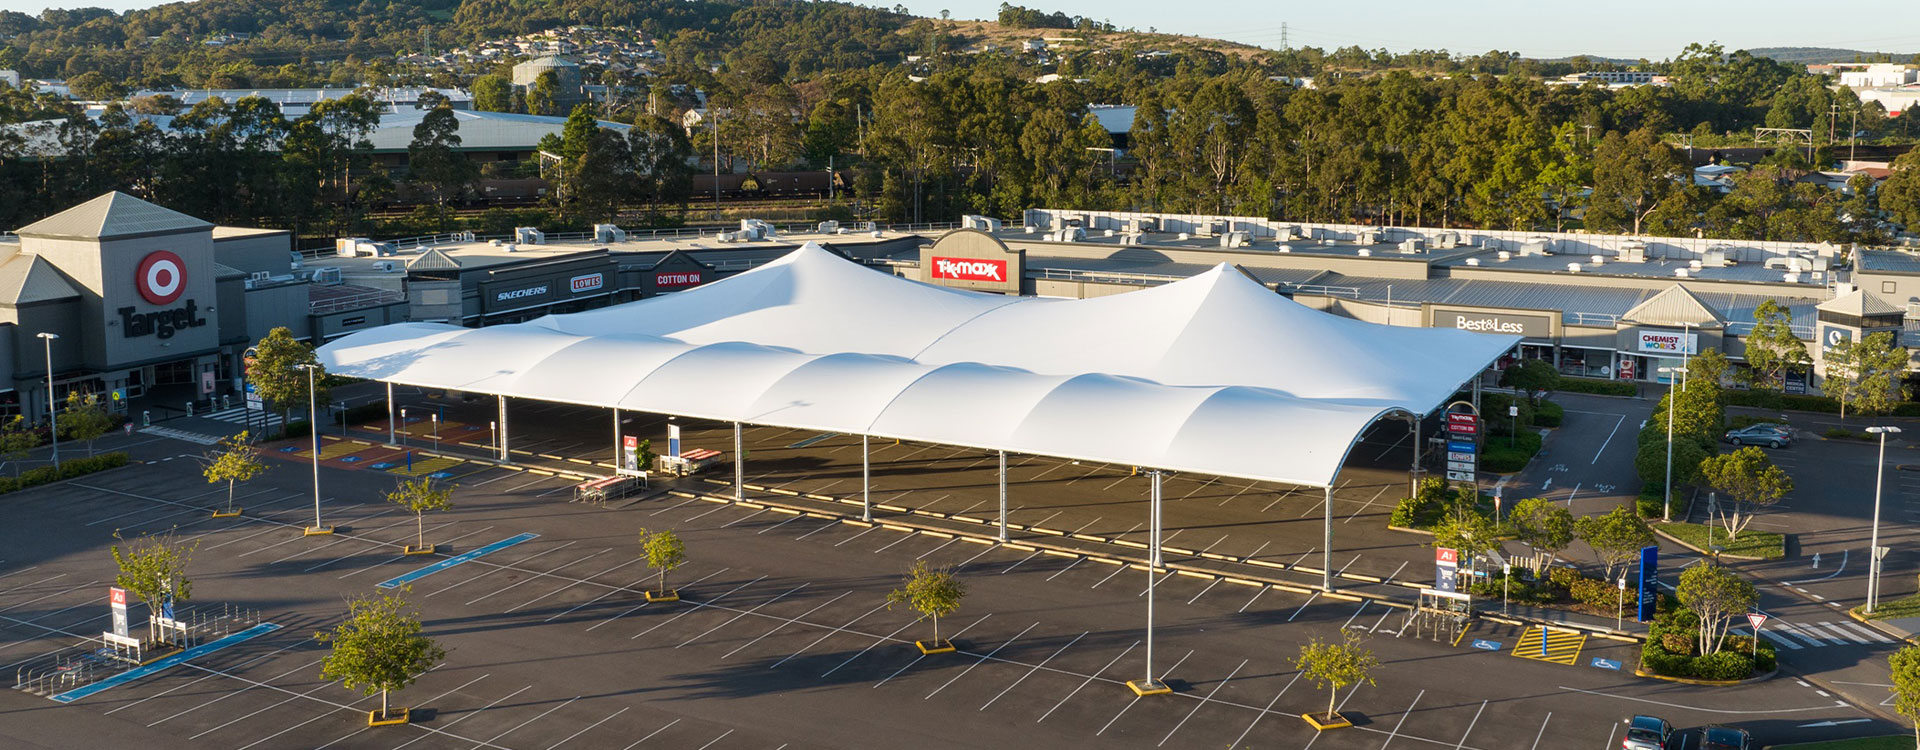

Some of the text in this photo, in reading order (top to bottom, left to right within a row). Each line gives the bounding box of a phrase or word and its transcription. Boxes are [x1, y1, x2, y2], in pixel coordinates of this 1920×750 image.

[574, 277, 601, 289] LOWES
[658, 274, 700, 284] COTTON ON
[497, 286, 548, 301] SKECHERS
[1456, 315, 1524, 333] Best&Less
[1642, 335, 1679, 343] CHEMIST
[1645, 342, 1676, 350] WORKS
[1441, 551, 1452, 561] A1
[113, 592, 123, 602] A3
